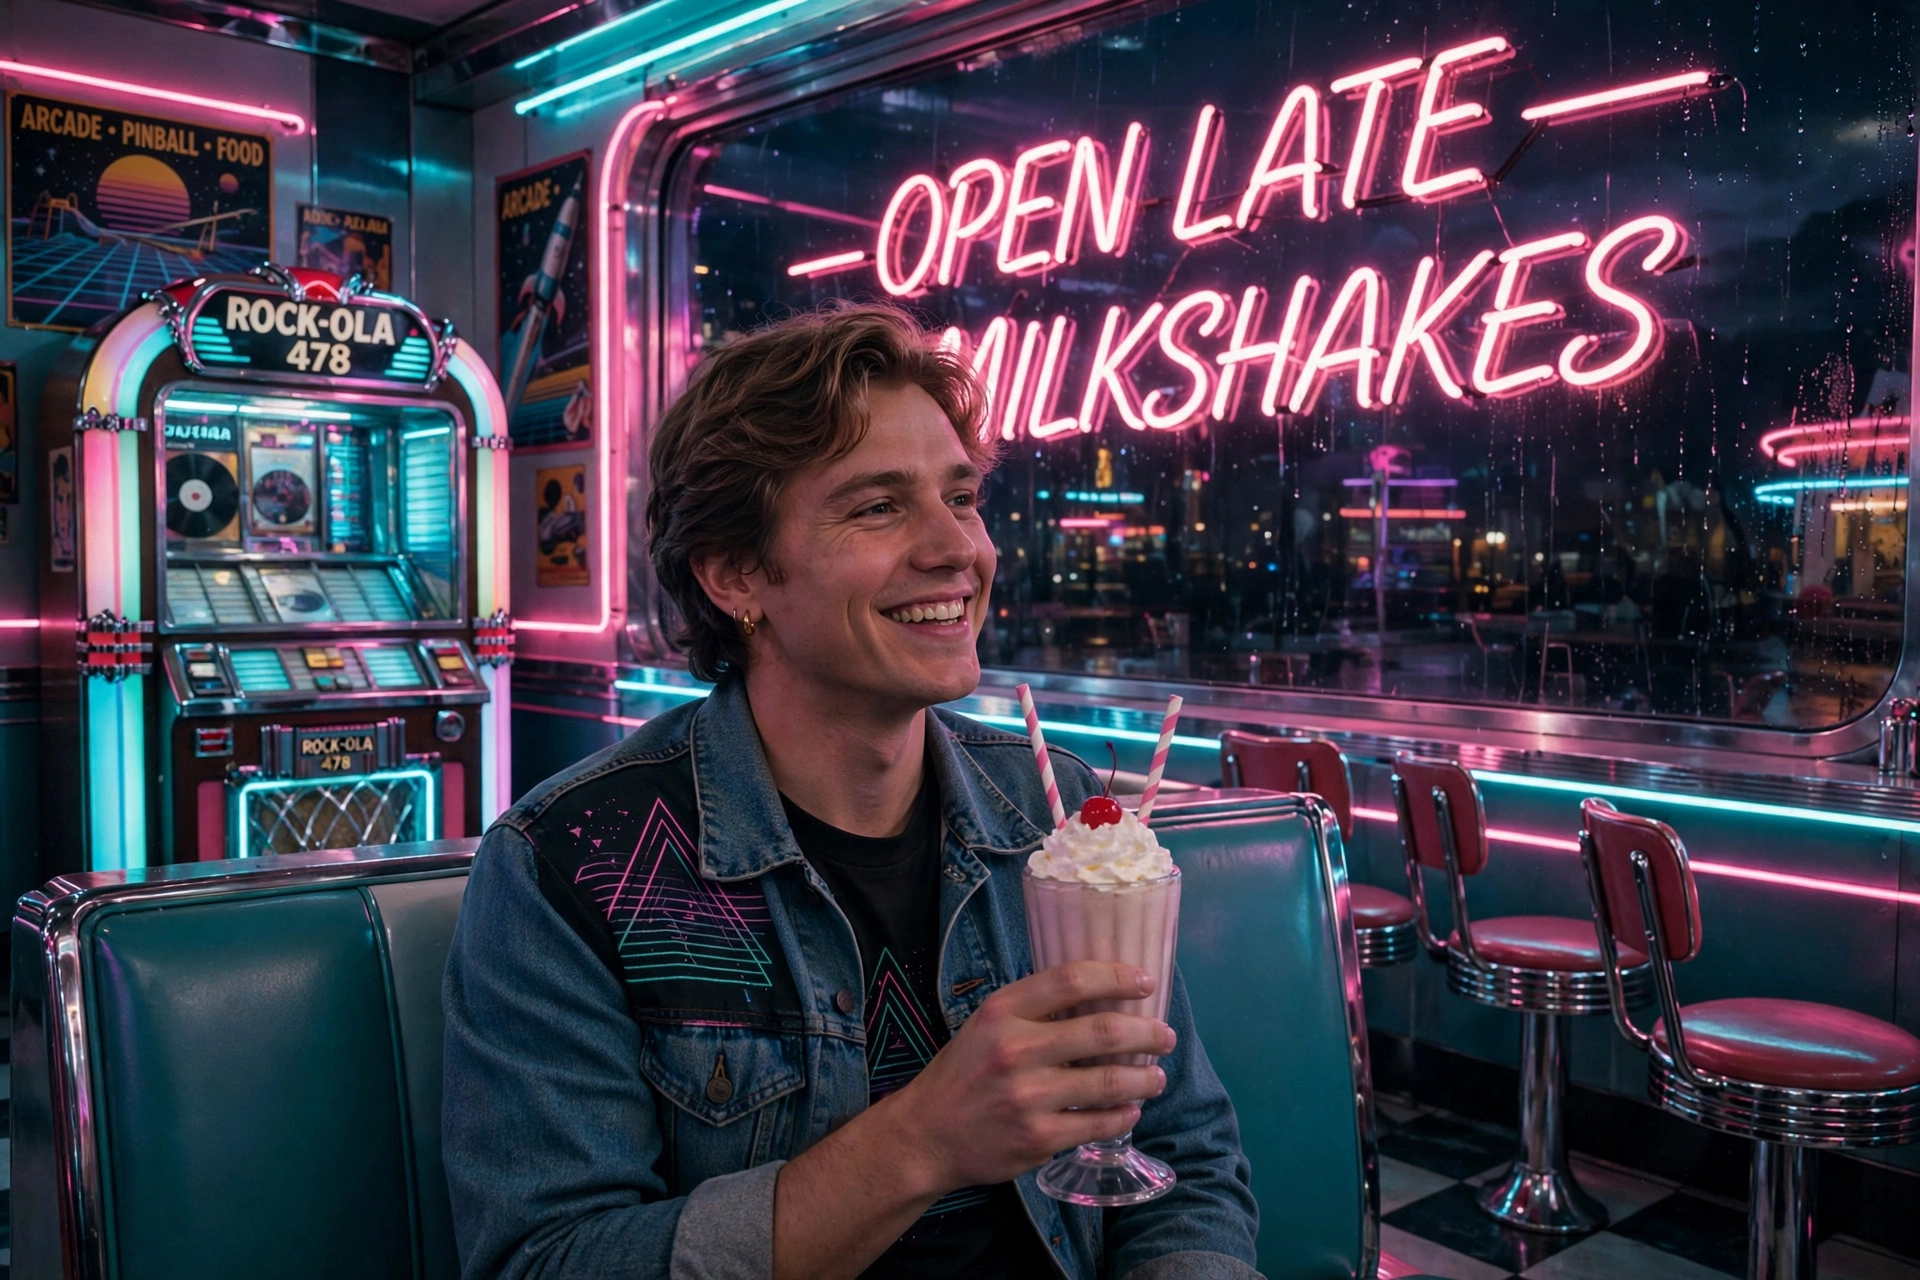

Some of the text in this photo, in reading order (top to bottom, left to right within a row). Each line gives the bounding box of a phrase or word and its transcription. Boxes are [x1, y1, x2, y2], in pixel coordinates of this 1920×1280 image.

[21, 103, 264, 167] ARCADE PINBALL FOOD
[875, 35, 1513, 297] OPEN LATE
[502, 178, 551, 220] ARCADE
[226, 295, 396, 346] ROCK-OLA
[286, 340, 351, 375] 478
[302, 736, 374, 755] ROCK-OLA
[321, 755, 351, 772] 478
